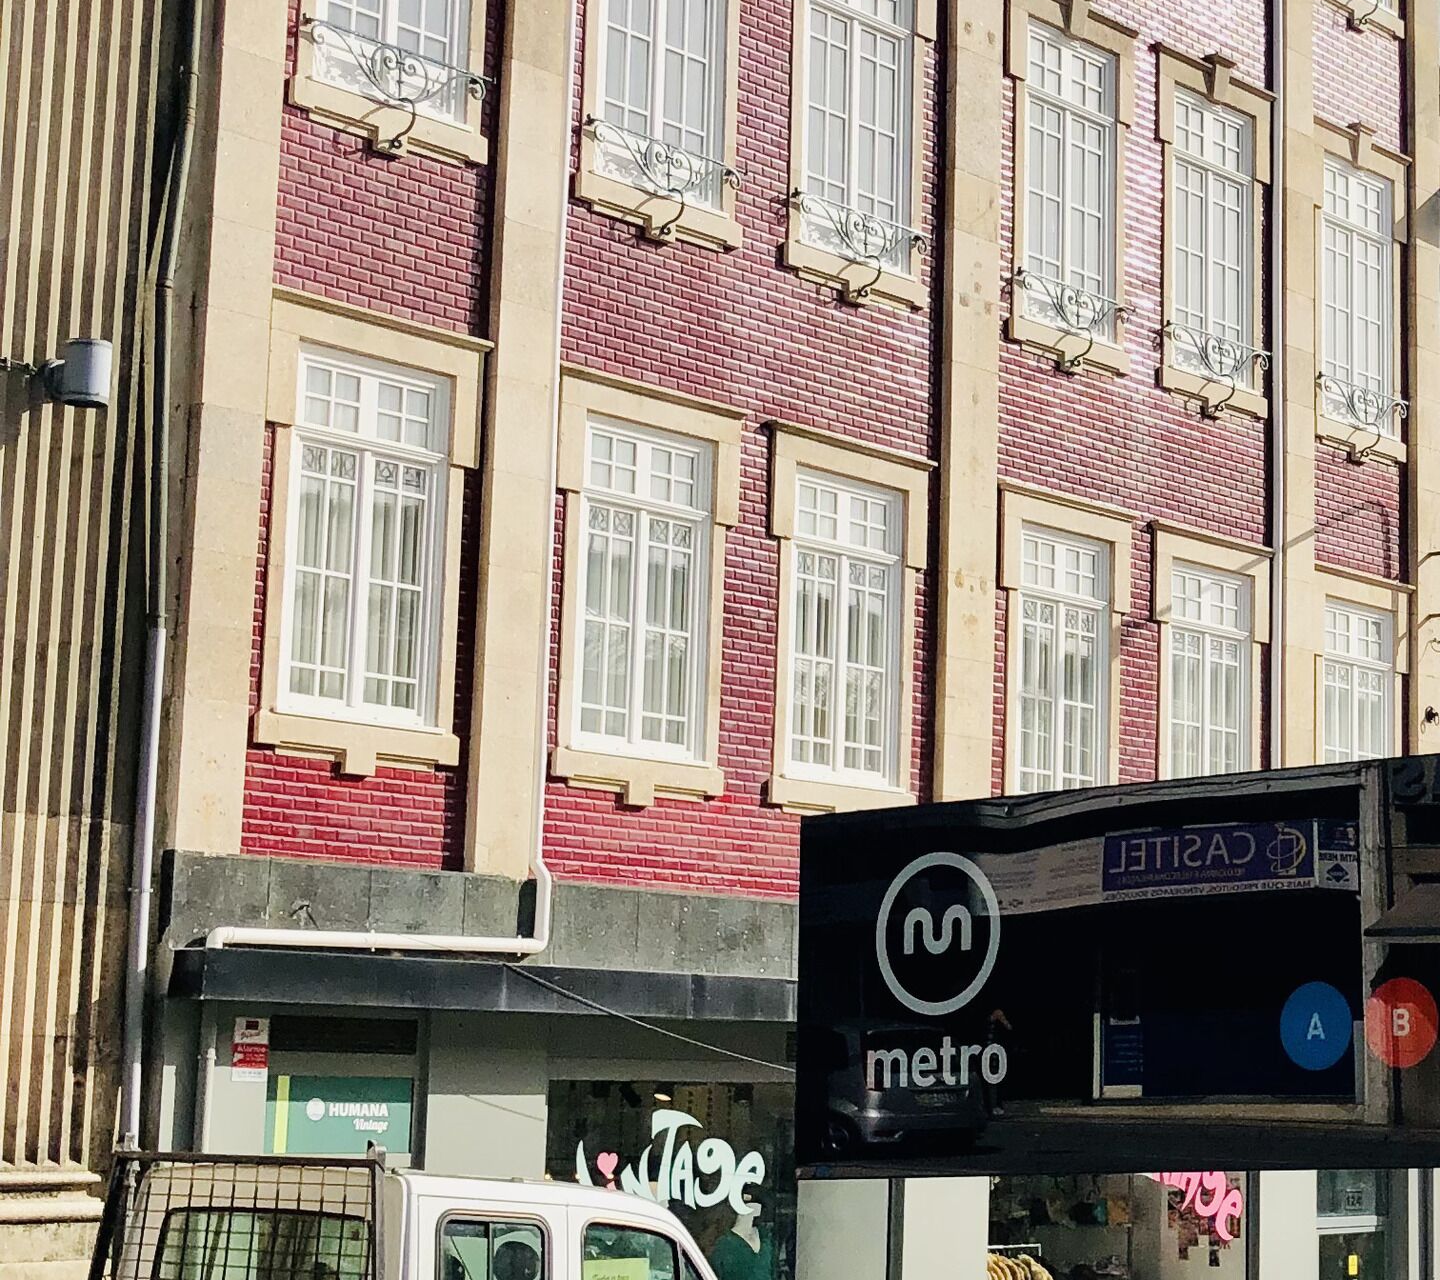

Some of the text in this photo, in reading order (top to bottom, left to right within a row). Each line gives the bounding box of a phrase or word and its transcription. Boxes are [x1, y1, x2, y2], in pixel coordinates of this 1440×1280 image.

[1307, 1013, 1325, 1041] A
[1393, 1009, 1410, 1037] B
[866, 1035, 1007, 1090] metro
[328, 1103, 389, 1117] HUMANA
[353, 1119, 389, 1133] Vintage
